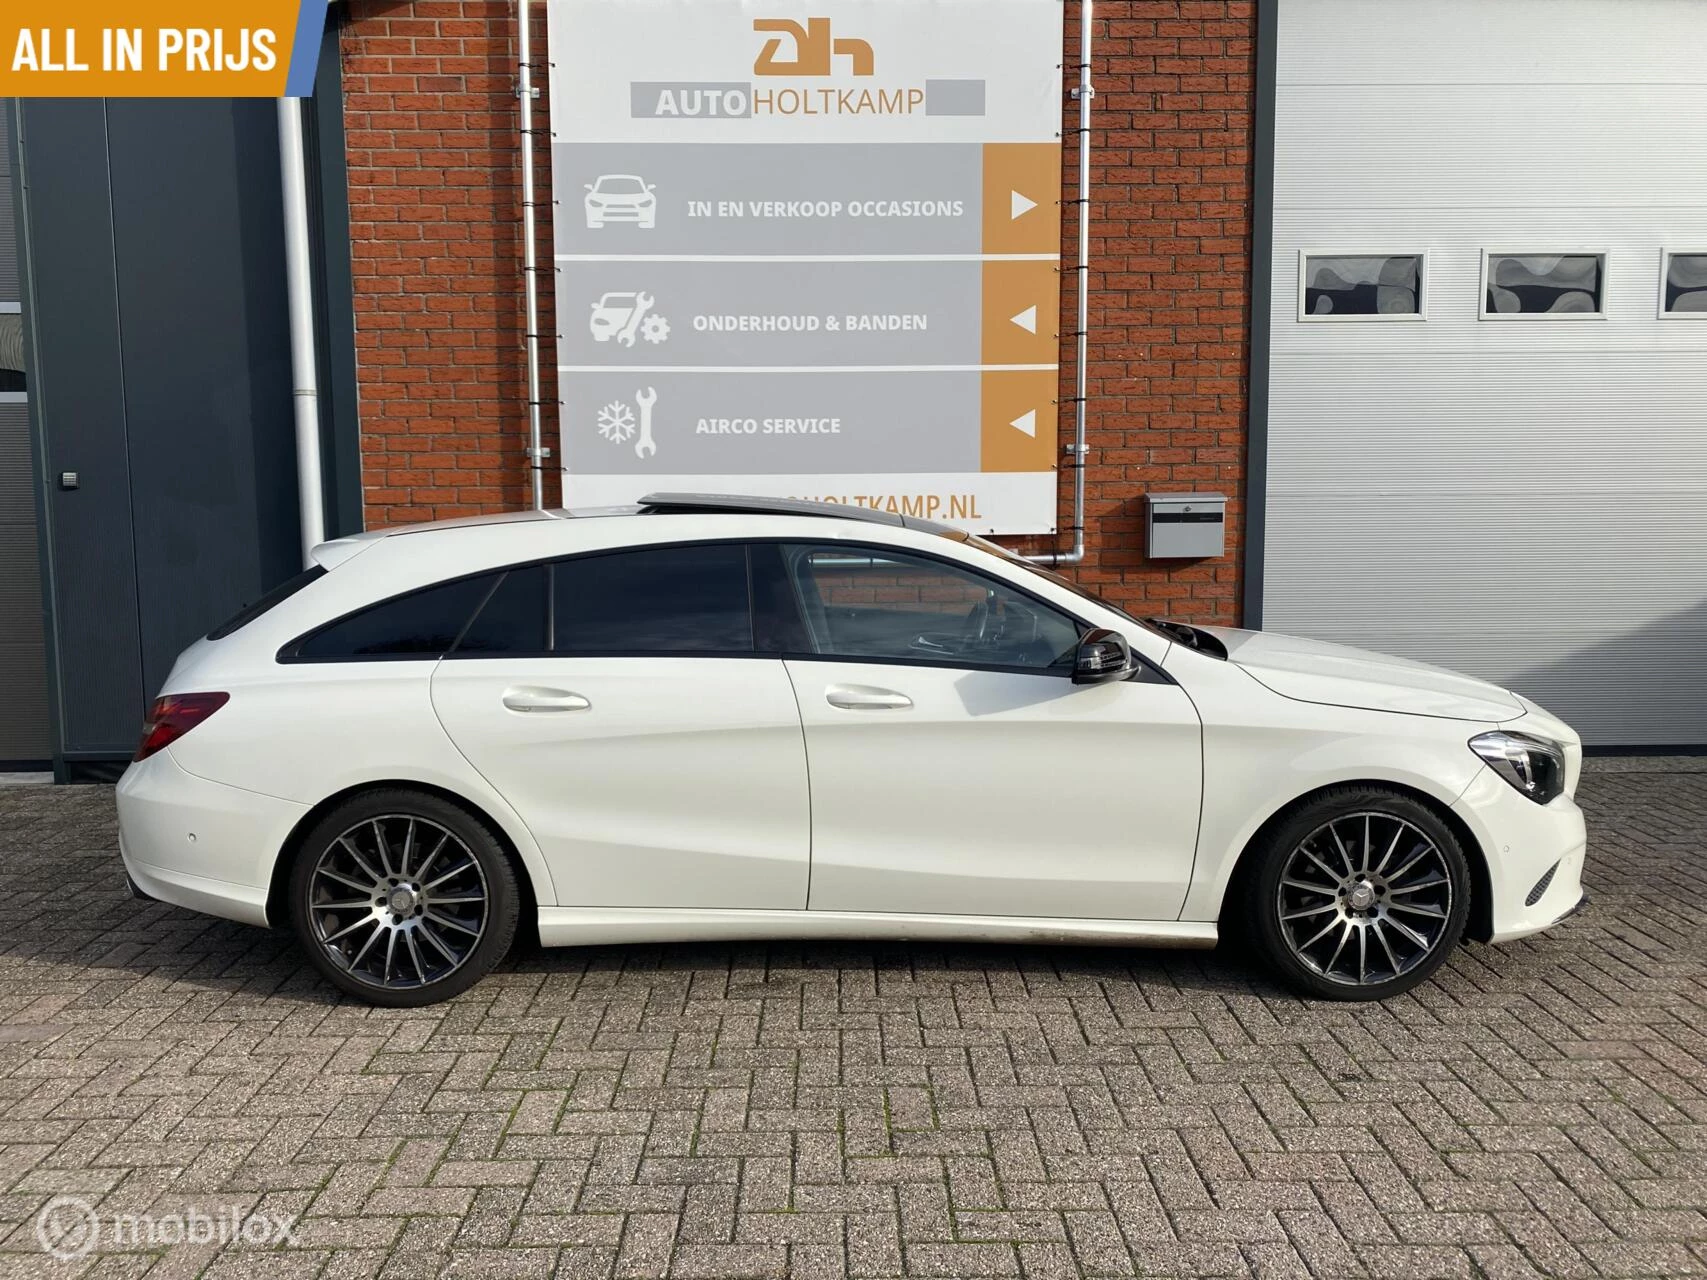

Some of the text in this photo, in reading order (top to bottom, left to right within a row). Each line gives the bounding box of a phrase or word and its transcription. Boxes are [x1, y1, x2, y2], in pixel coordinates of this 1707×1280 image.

[687, 200, 964, 218] IN EN VERKOOP OCCASIONS
[692, 313, 928, 332] ONDERHOUD & BANDEN
[695, 417, 841, 435] AIRCO SERVICE
